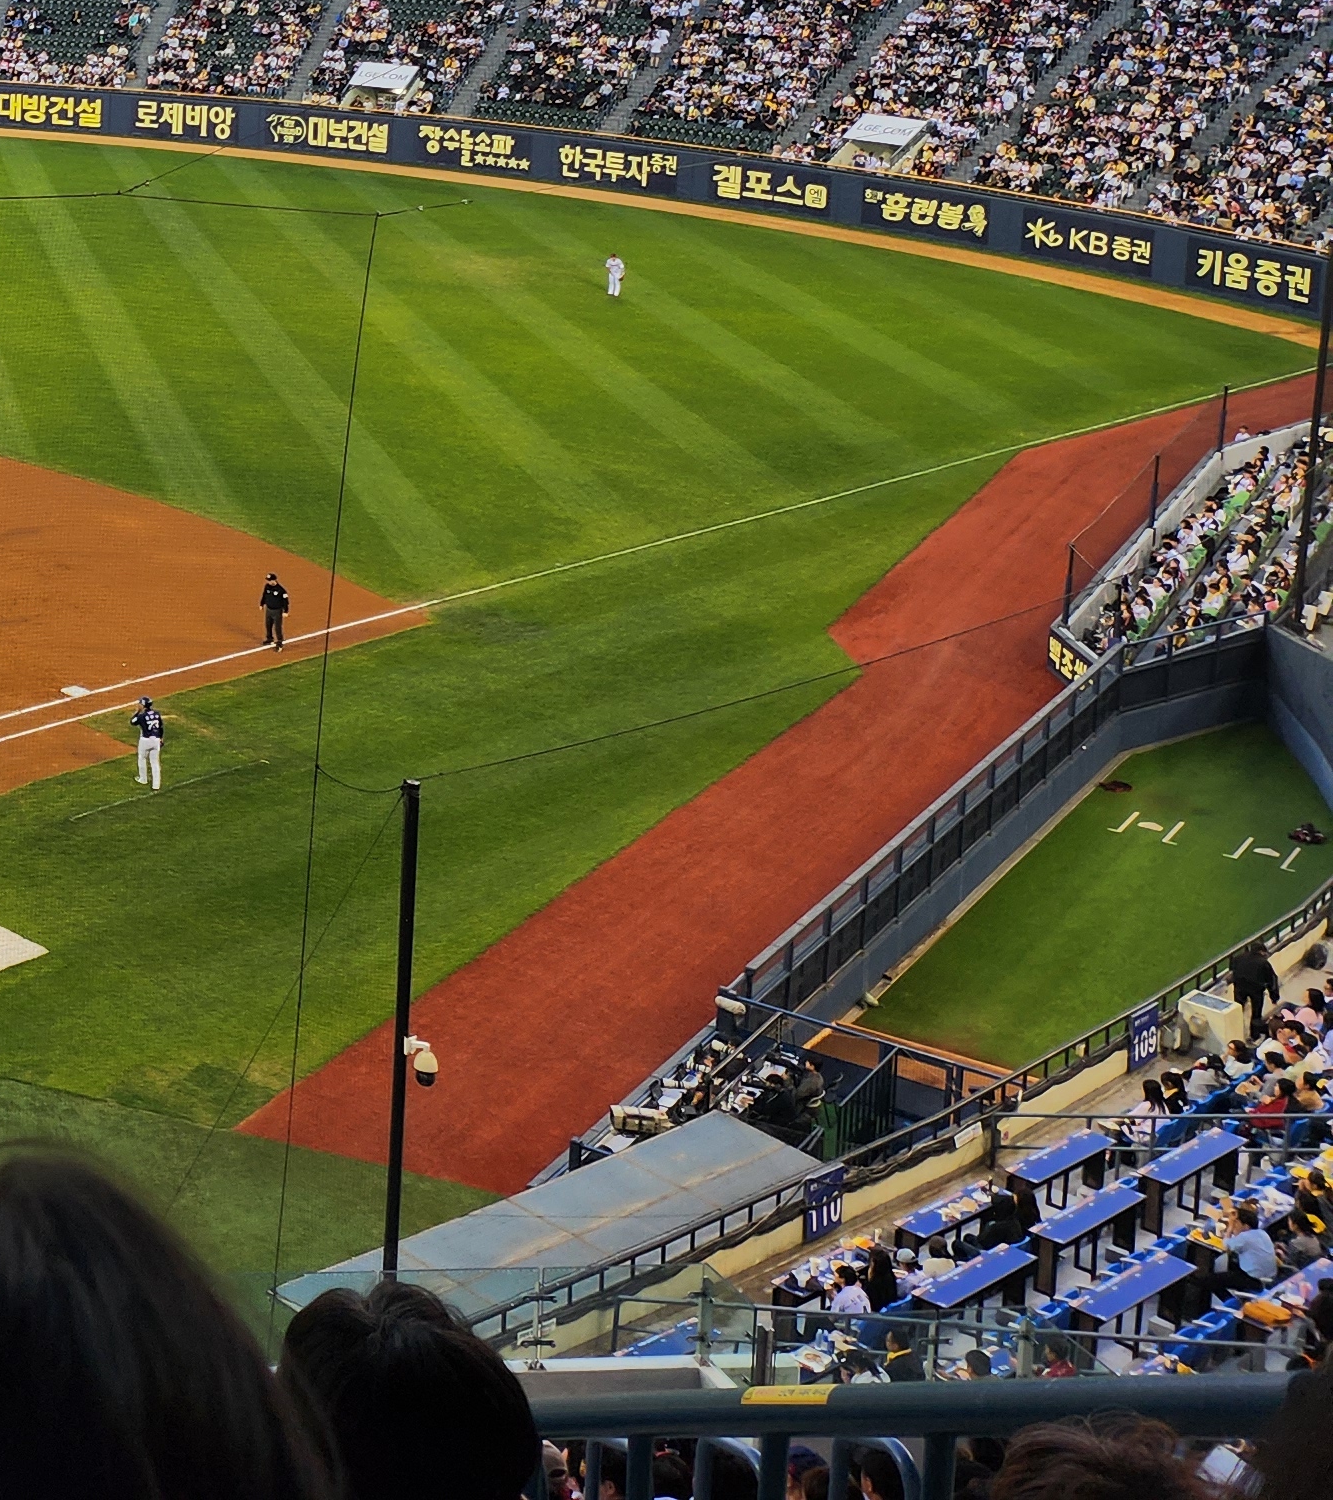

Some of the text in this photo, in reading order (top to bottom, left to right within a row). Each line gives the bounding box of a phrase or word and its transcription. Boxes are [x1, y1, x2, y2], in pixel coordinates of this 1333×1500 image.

[357, 70, 411, 82] LGE.COM
[135, 100, 235, 140] 로제비앙
[308, 116, 389, 154] 대보건설
[856, 122, 915, 138] LGE.COM
[713, 165, 805, 206] 겔포스
[1069, 227, 1152, 264] KB 증권
[1197, 248, 1312, 304] 키움증권
[1133, 1025, 1157, 1062] 109
[808, 1190, 841, 1233] 110
